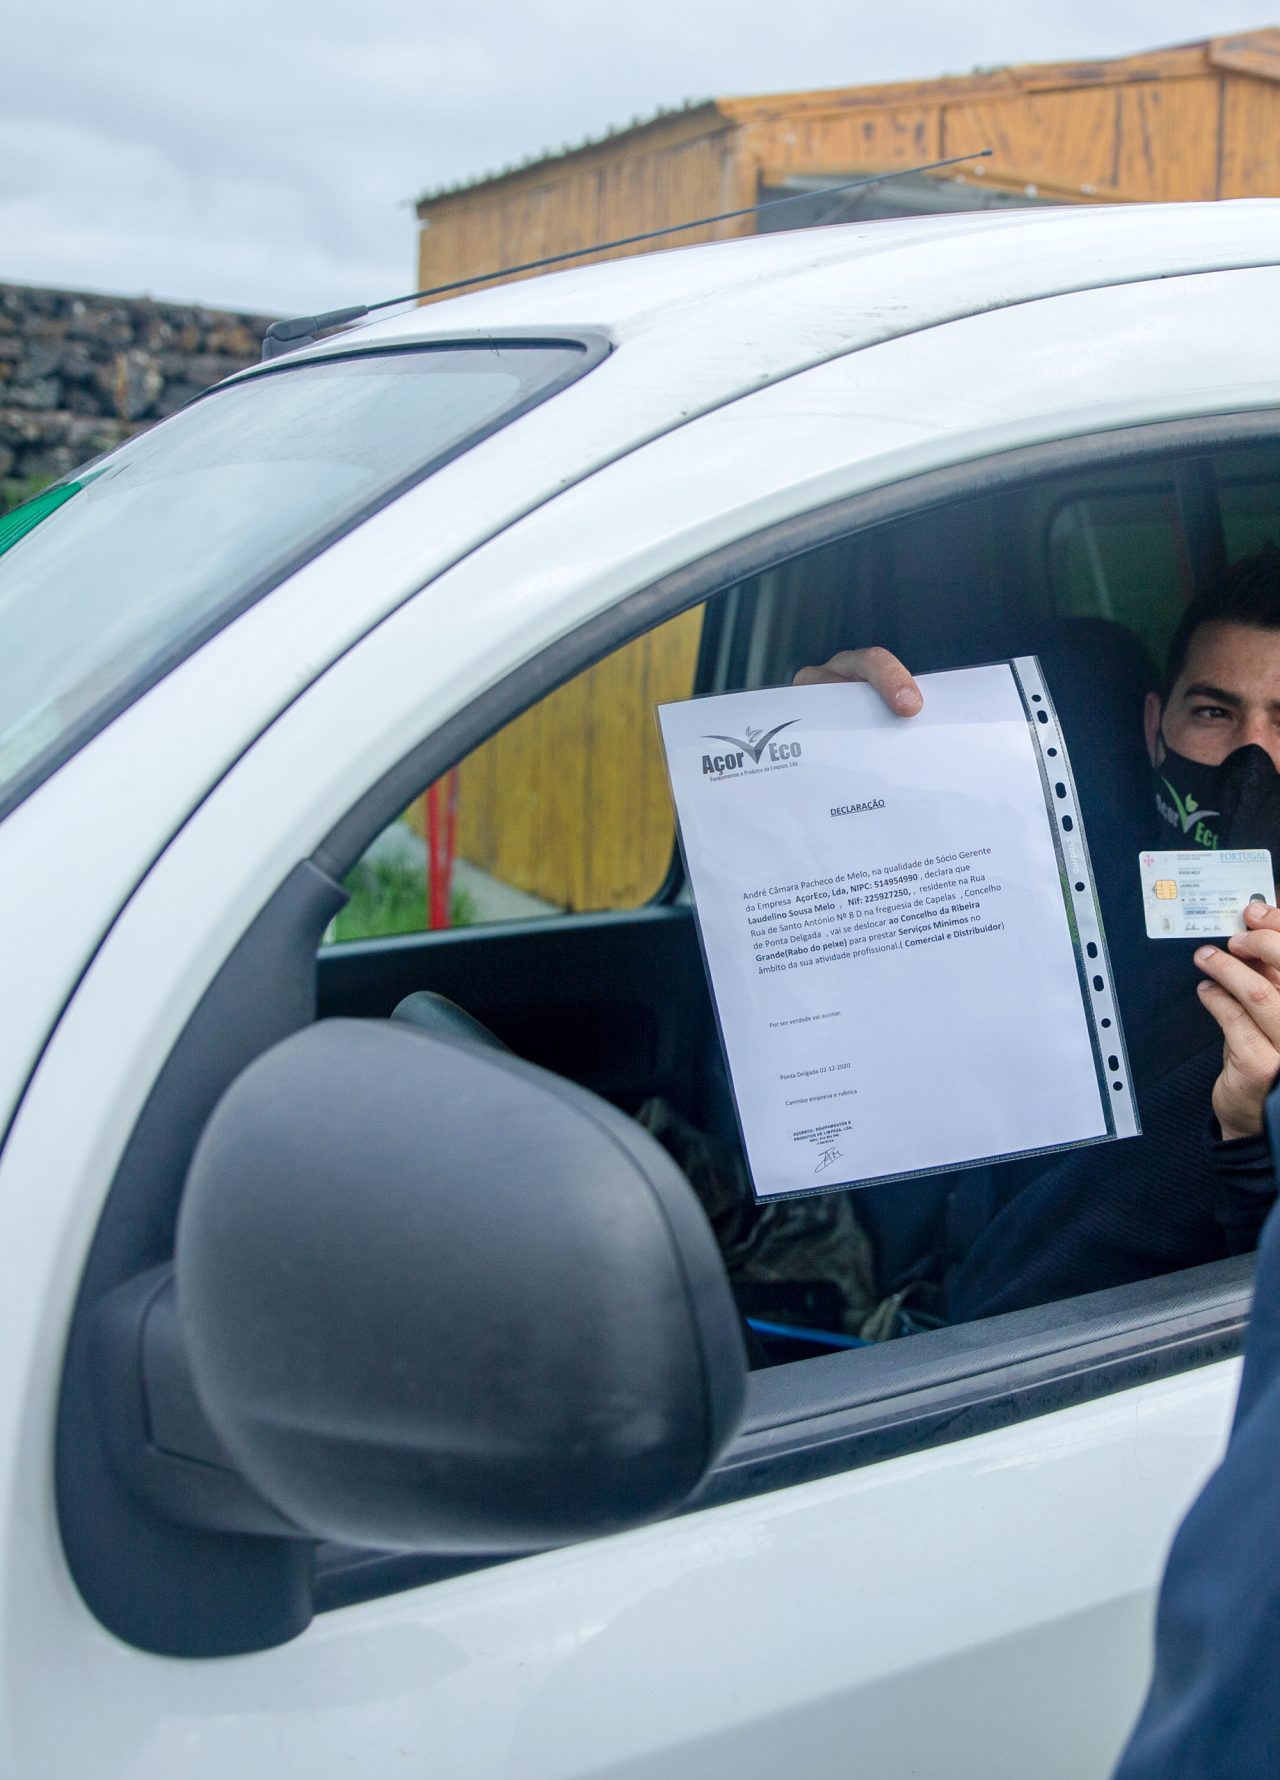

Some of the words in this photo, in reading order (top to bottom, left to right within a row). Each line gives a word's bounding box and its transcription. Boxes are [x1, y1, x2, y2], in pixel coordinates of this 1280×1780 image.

[702, 751, 744, 775] Açor
[768, 741, 802, 762] Eco
[830, 799, 885, 817] DECLARAÇÃO
[743, 888, 768, 901] André
[768, 884, 800, 896] Câmara
[800, 877, 834, 890] Pacheco
[834, 874, 846, 883] de
[846, 869, 871, 881] Melo,
[871, 868, 882, 876] na
[883, 859, 923, 875] qualidade
[923, 857, 935, 866] de
[935, 853, 958, 864] Sócio
[958, 847, 992, 860] Gerente
[1219, 852, 1269, 861] PORTUGAL
[745, 904, 756, 913] da
[756, 898, 792, 911] Empresa
[795, 891, 831, 904] AçorEco,
[831, 887, 849, 897] Lda,
[849, 882, 873, 893] NIPC:
[873, 873, 919, 889] 514954990
[924, 868, 954, 879] declara
[954, 864, 971, 874] que
[747, 912, 788, 925] Laudelino
[788, 907, 813, 918] Sousa
[813, 902, 836, 913] Melo
[847, 896, 863, 907] Nif:
[919, 880, 957, 893] residente
[958, 878, 969, 886] na
[969, 874, 986, 883] Rua
[750, 929, 767, 938] Rua
[767, 925, 778, 935] de
[778, 922, 803, 933] Santo
[803, 915, 836, 928] António
[848, 911, 855, 920] 8
[855, 909, 863, 918] D
[863, 908, 875, 917] na
[875, 901, 912, 915] freguesia
[913, 898, 924, 907] de
[925, 892, 957, 905] Capelas
[964, 884, 1002, 898] Concelho
[753, 941, 764, 950] de
[764, 937, 789, 948] Ponta
[789, 930, 822, 943] Delgada
[829, 926, 842, 936] vai
[842, 926, 852, 934] se
[853, 919, 887, 932] deslocar
[888, 917, 900, 925] ao
[900, 909, 938, 923] Concelho
[939, 906, 950, 916] da
[950, 901, 981, 913] Ribeira
[755, 946, 809, 962] Grande(Rabo
[809, 943, 821, 953] do
[822, 937, 848, 952] peixe)
[848, 936, 867, 947] para
[868, 930, 897, 943] prestar
[898, 924, 932, 936] Serviços
[932, 917, 969, 930] Mínimos
[970, 914, 981, 922] no
[758, 964, 787, 975] âmbito
[787, 960, 799, 970] da
[799, 959, 814, 967] sua
[815, 951, 851, 965] atividade
[904, 932, 945, 948] Comercial
[953, 921, 1005, 939] Distribuidor)
[788, 1015, 812, 1025] verdade
[779, 1073, 797, 1081] Ponta
[796, 1068, 820, 1078] Delgada
[819, 1062, 851, 1074] 02-12-2020
[785, 1098, 809, 1106] Carimbo
[808, 1093, 833, 1102] empresa
